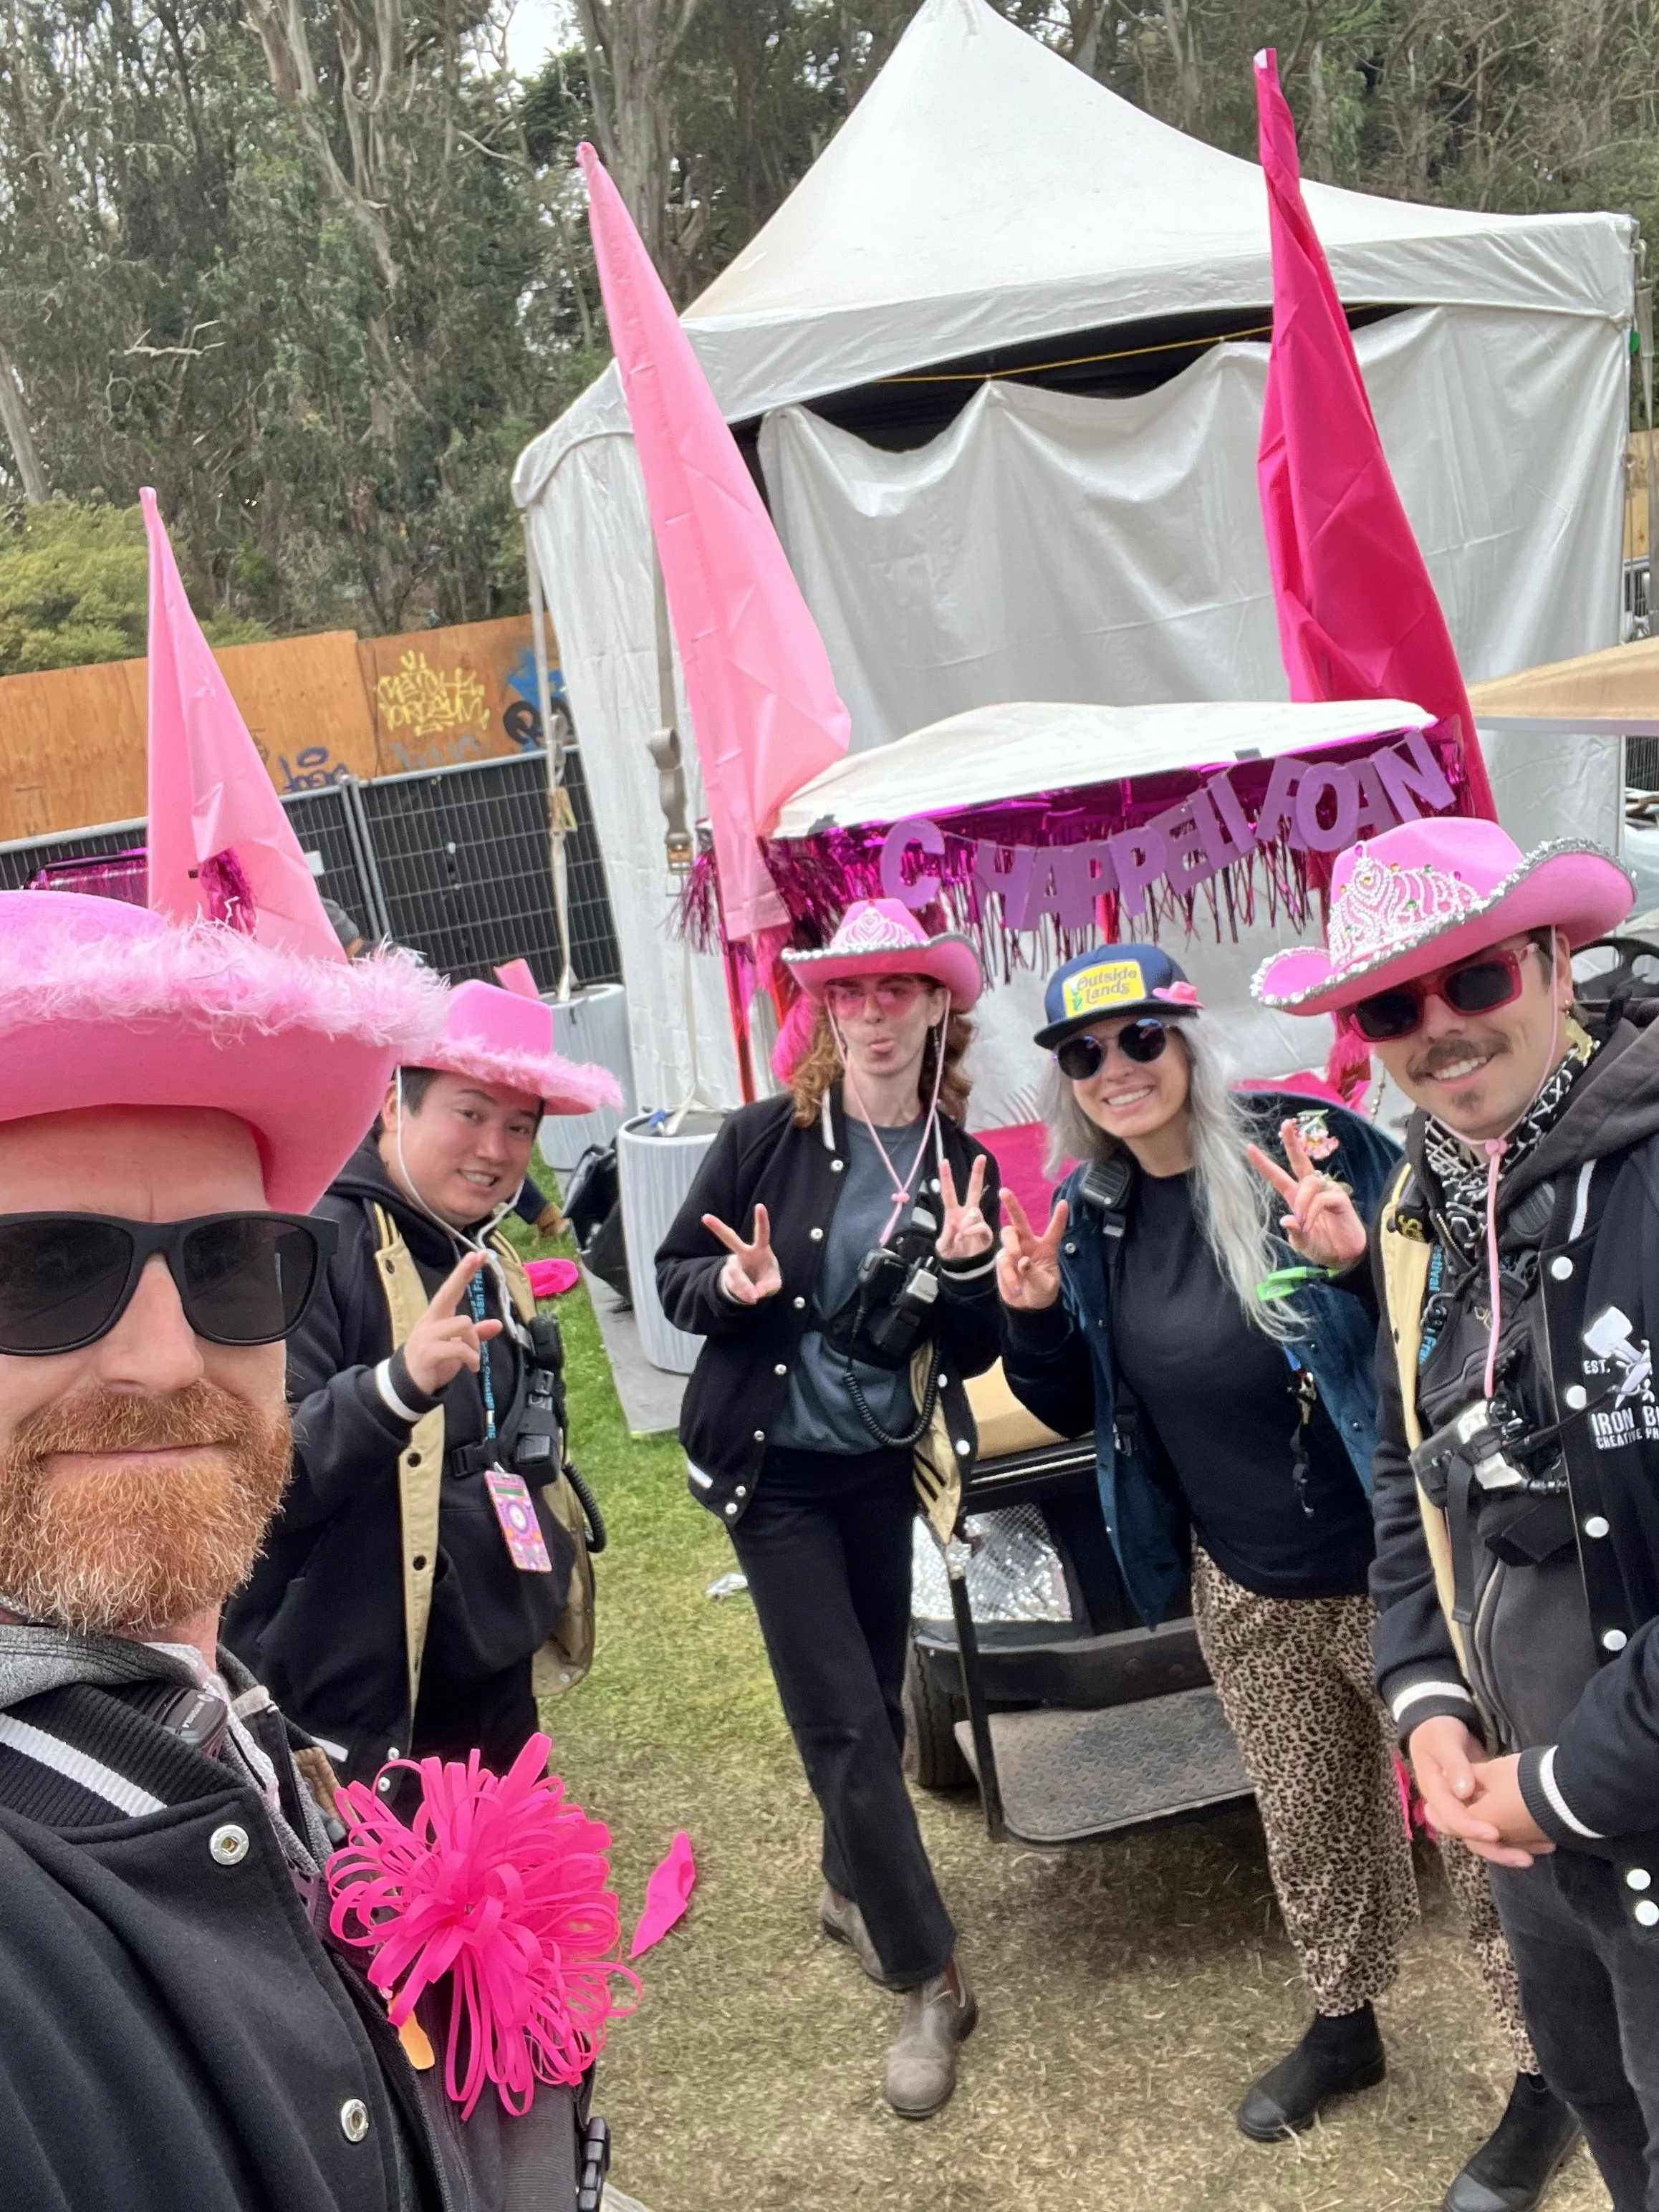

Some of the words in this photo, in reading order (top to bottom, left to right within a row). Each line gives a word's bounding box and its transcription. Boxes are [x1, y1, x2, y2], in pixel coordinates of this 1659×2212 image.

[880, 772, 1256, 931] CHAPPELL
[1255, 729, 1456, 852] ROAN
[1077, 967, 1138, 991] Outside
[1085, 979, 1130, 1004] Lands
[1583, 1360, 1611, 1375] EST.
[1591, 1408, 1635, 1436] IRON
